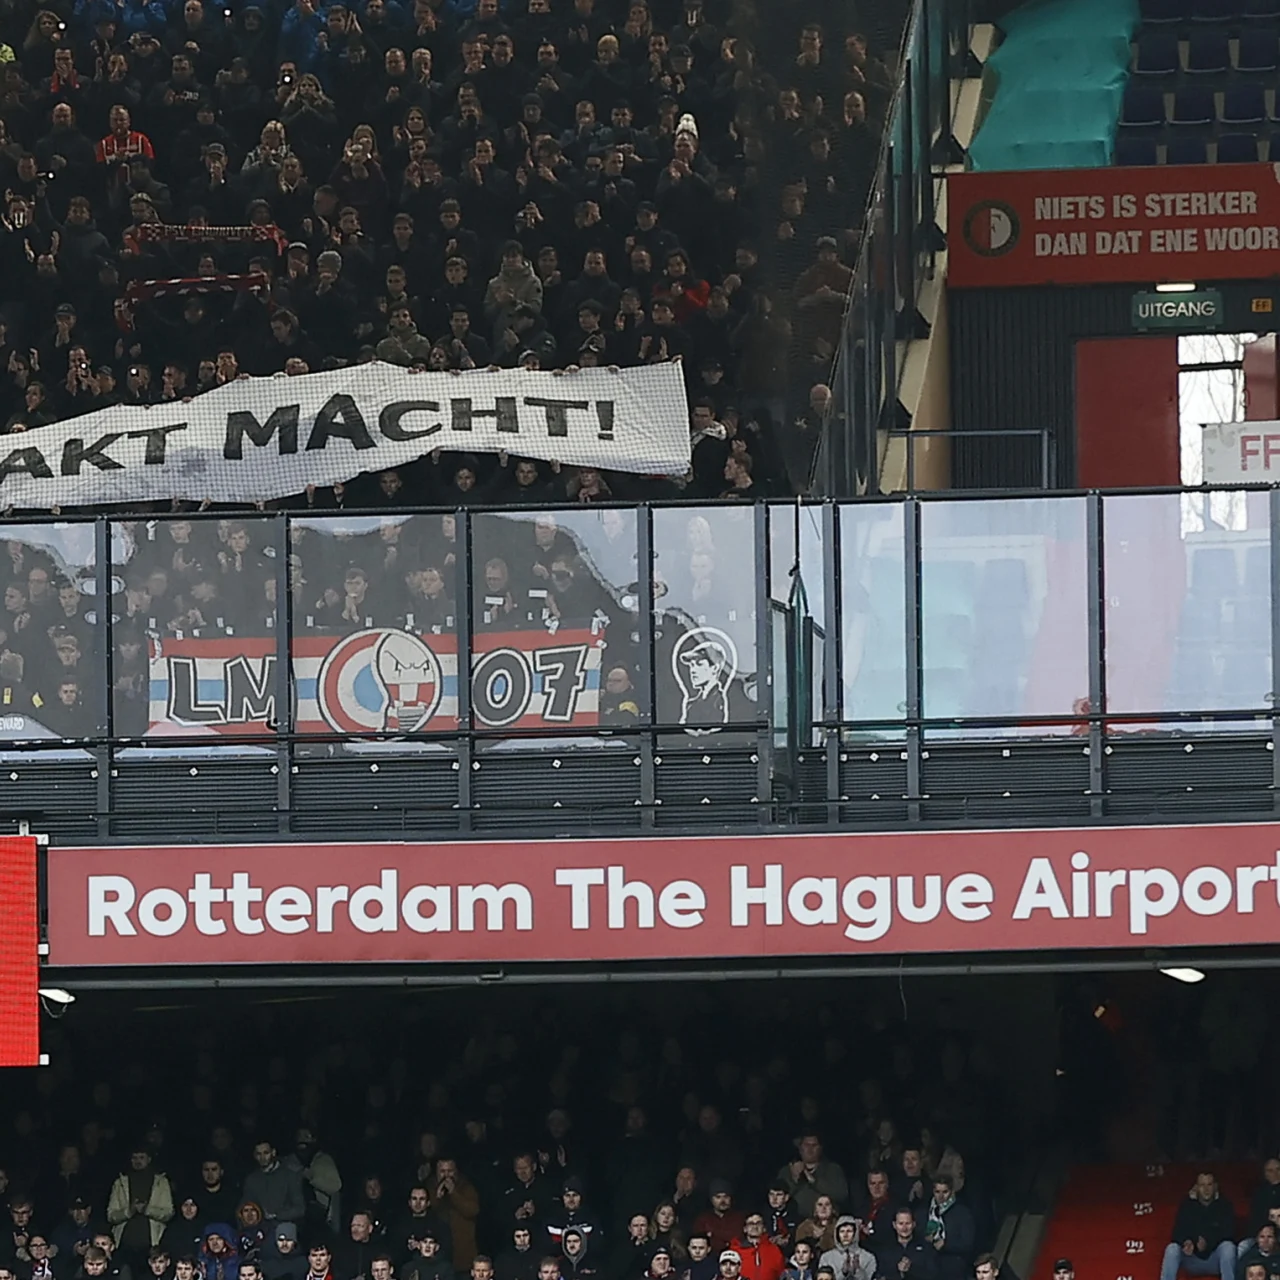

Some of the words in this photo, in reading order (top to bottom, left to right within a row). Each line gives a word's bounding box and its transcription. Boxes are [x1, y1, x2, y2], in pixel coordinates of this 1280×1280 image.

[1034, 196, 1105, 220] NIETS
[1113, 194, 1137, 218] IS
[1145, 191, 1258, 218] STERKER
[1035, 232, 1087, 256] DAN
[1095, 230, 1142, 254] DAT
[1150, 228, 1198, 252] ENE
[1138, 301, 1216, 317] UITGANG
[223, 393, 615, 460] MACHT!
[471, 643, 588, 726] 07
[88, 870, 533, 936] Rotterdam
[555, 866, 706, 929] The
[730, 863, 995, 942] Hague
[1012, 851, 1280, 934] Airpor
